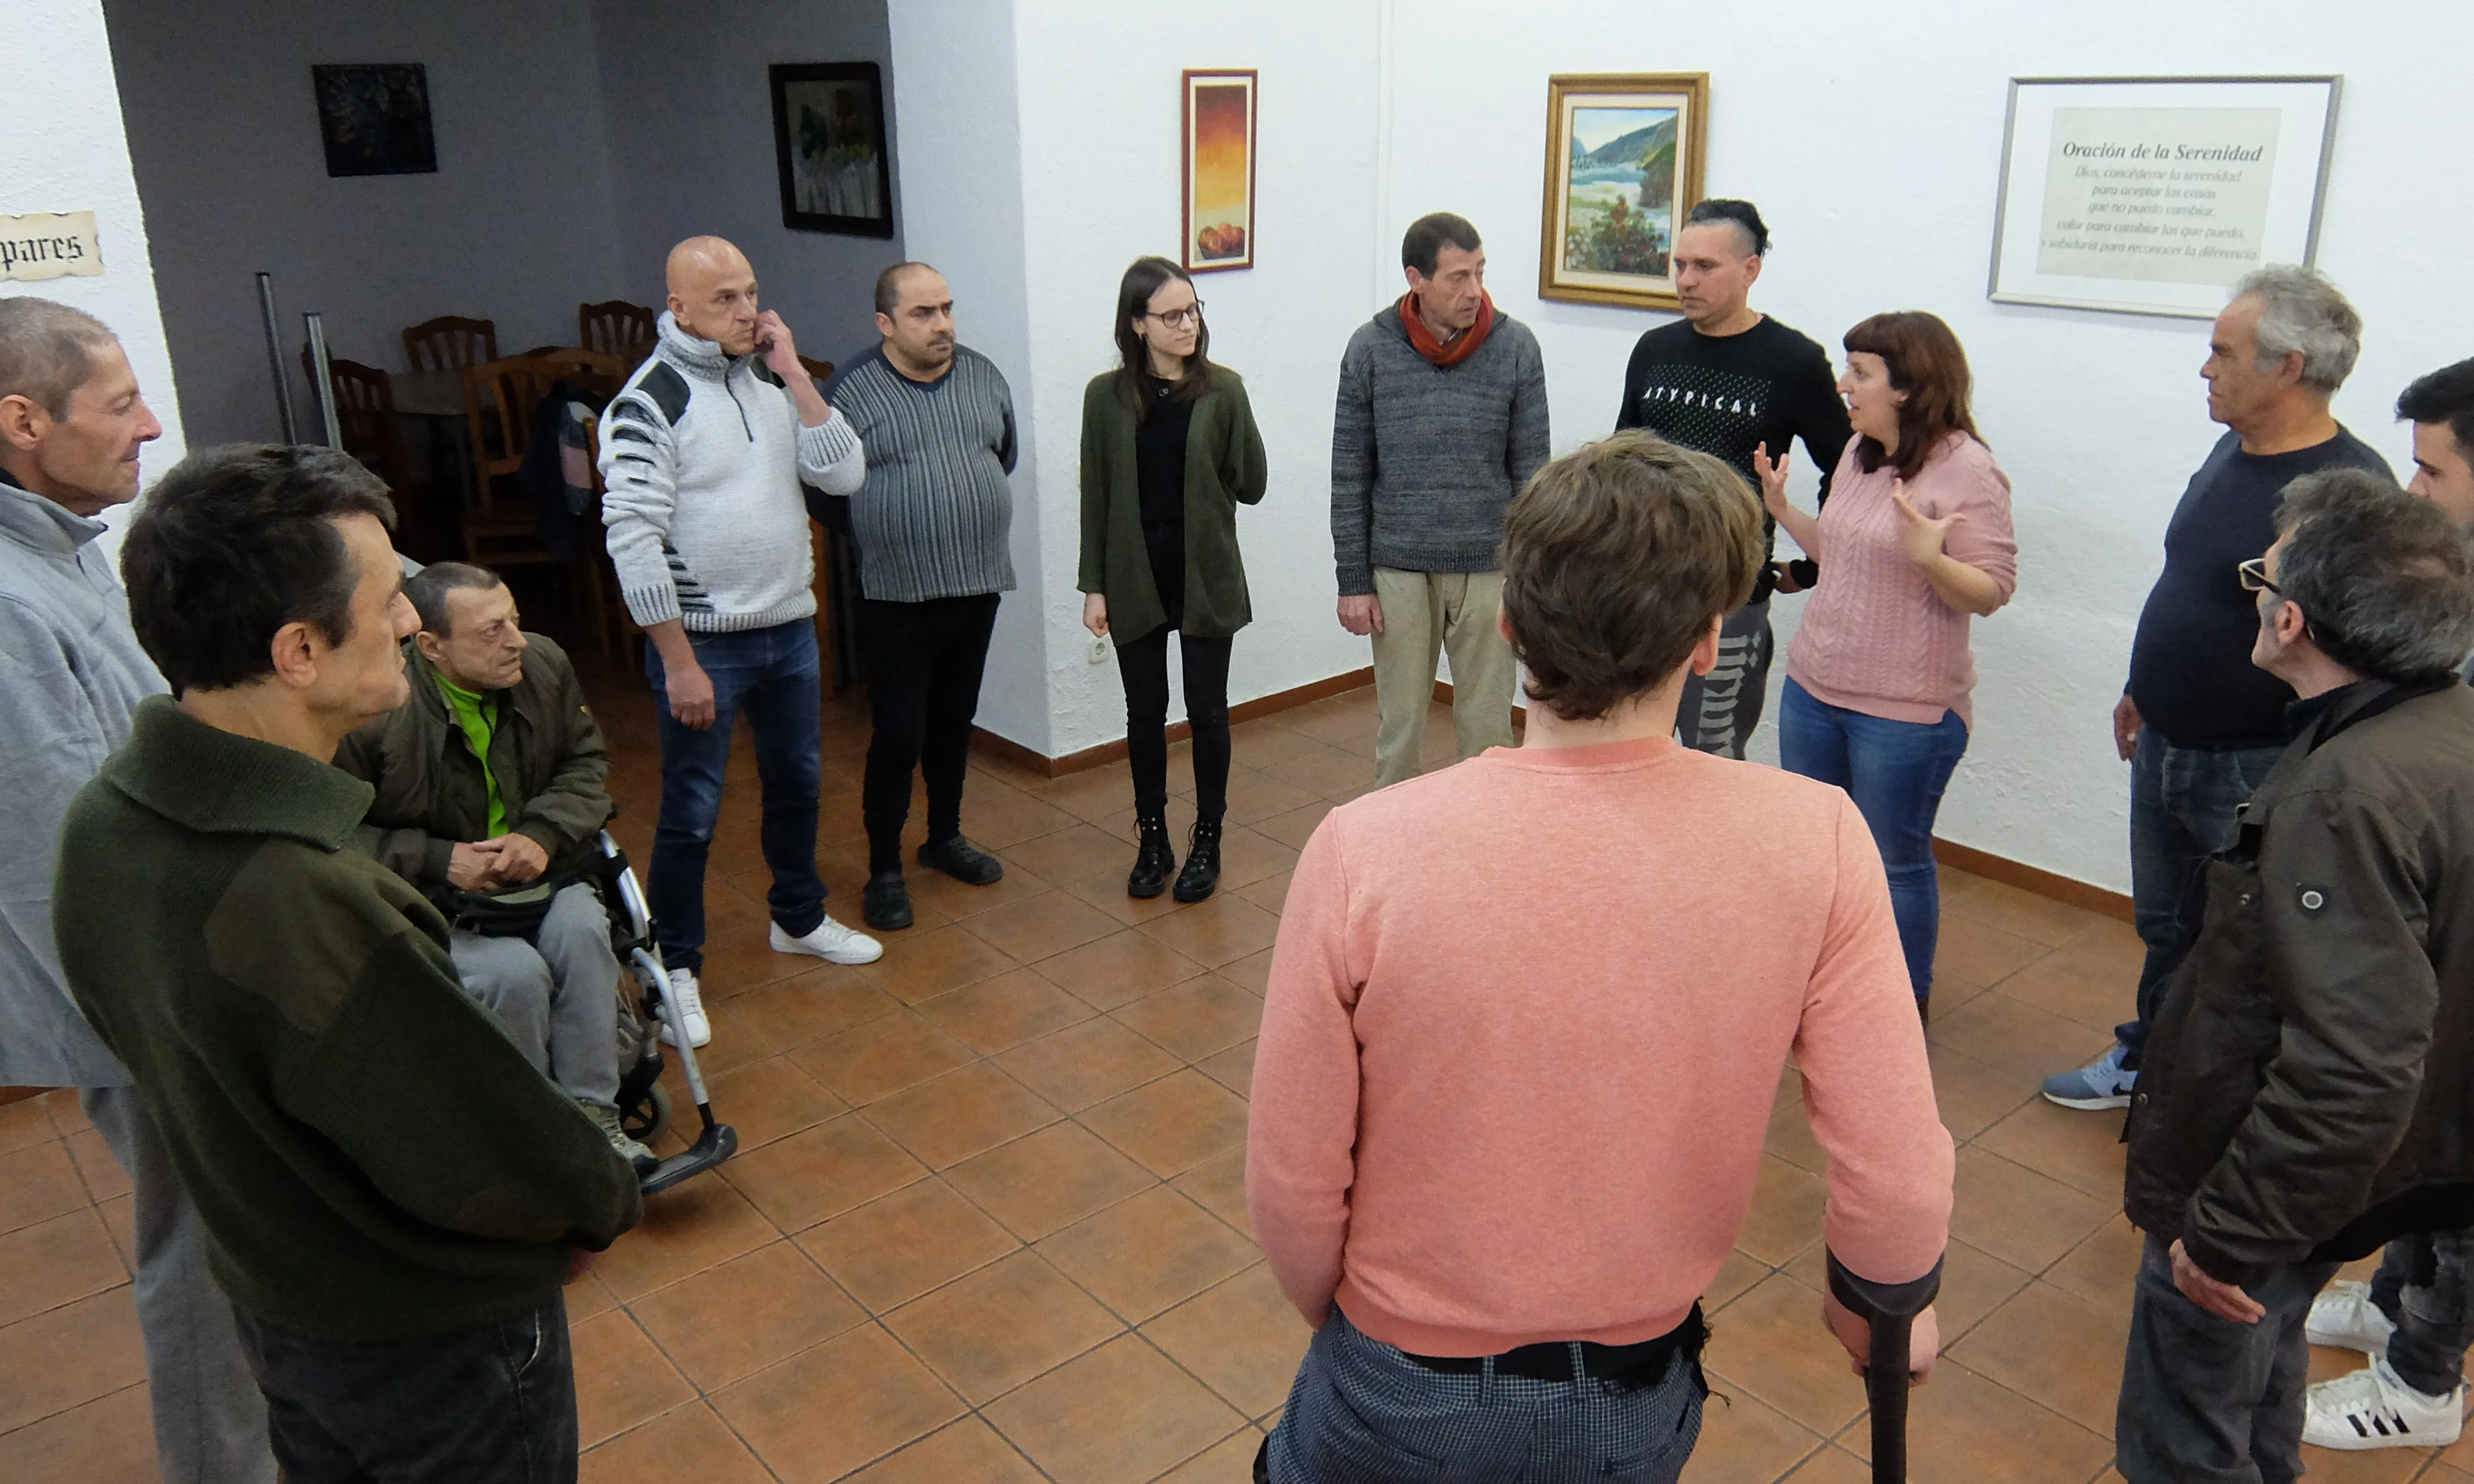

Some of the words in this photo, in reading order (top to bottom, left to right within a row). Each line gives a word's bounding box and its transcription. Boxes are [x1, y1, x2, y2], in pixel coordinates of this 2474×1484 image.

[2063, 141, 2126, 158] Oración
[2131, 143, 2151, 159] de
[2154, 143, 2170, 160] la
[2174, 143, 2263, 161] Serenidad
[2074, 165, 2100, 178] Dios,
[2169, 169, 2181, 180] la
[2183, 169, 2243, 182] serenidad
[2091, 186, 2118, 197] para
[2120, 187, 2163, 198] aceptar
[2165, 186, 2181, 197] las
[2183, 189, 2217, 198] cosas
[2088, 202, 2110, 214] que
[2111, 203, 2126, 213] no
[2127, 203, 2164, 215] puedo
[2057, 218, 2085, 230] valor
[2085, 222, 2112, 232] para
[2114, 222, 2159, 234] cambiar
[2162, 223, 2178, 236] las
[2181, 228, 2203, 239] que
[0, 236, 84, 272] pares
[2049, 237, 2099, 251] sabiduría
[2099, 244, 2126, 254] para
[2128, 245, 2182, 256] reconocer
[2185, 245, 2197, 257] la
[1643, 386, 1757, 417] ATYPICAL
